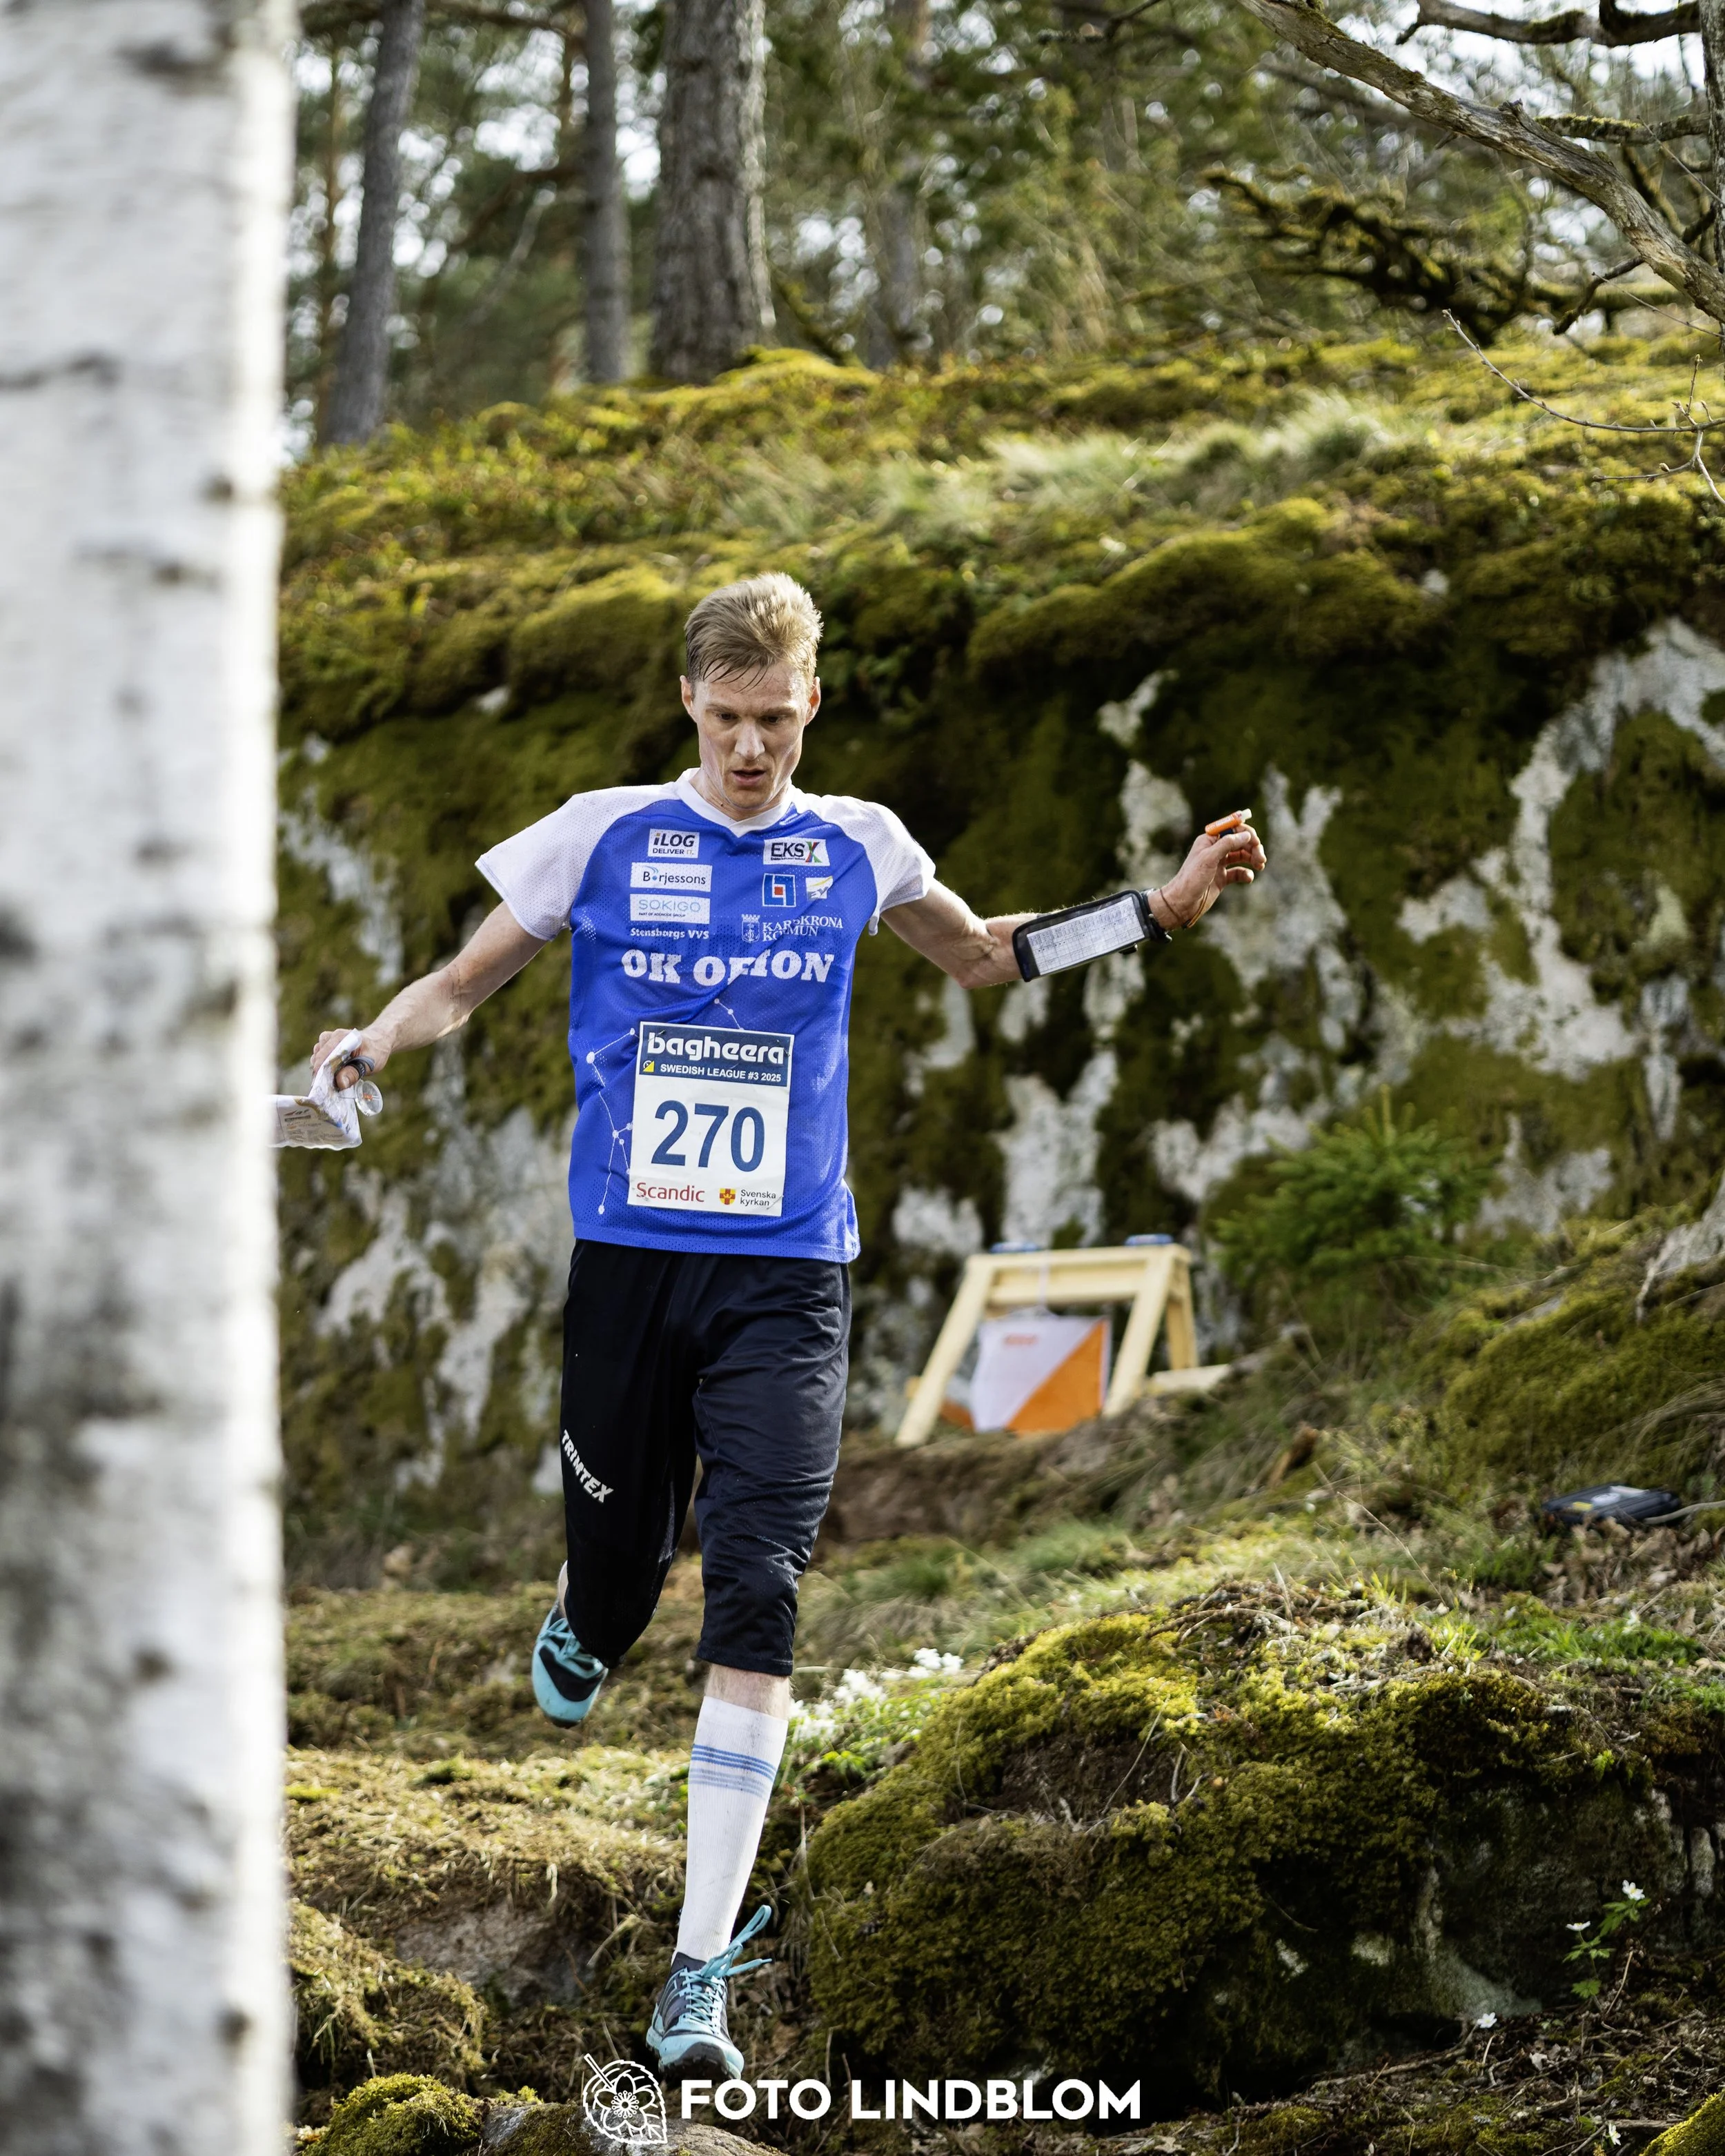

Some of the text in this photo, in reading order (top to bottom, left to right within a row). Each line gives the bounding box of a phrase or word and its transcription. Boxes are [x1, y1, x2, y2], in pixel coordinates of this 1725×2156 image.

[653, 833, 696, 848] iLOG
[638, 899, 701, 913] SOKIGO
[688, 929, 709, 939] VVS
[762, 925, 819, 942] KOMUN
[621, 949, 682, 984] OK
[647, 1031, 784, 1065] bagheera
[660, 1063, 782, 1082] SWEDISH LEAGUE #3 2025
[651, 1100, 765, 1172] 270
[636, 1182, 705, 1203] Scandic
[740, 1189, 776, 1199] Svenska
[740, 1196, 770, 1207] kyrkan
[562, 1429, 614, 1503] TRIMTEX
